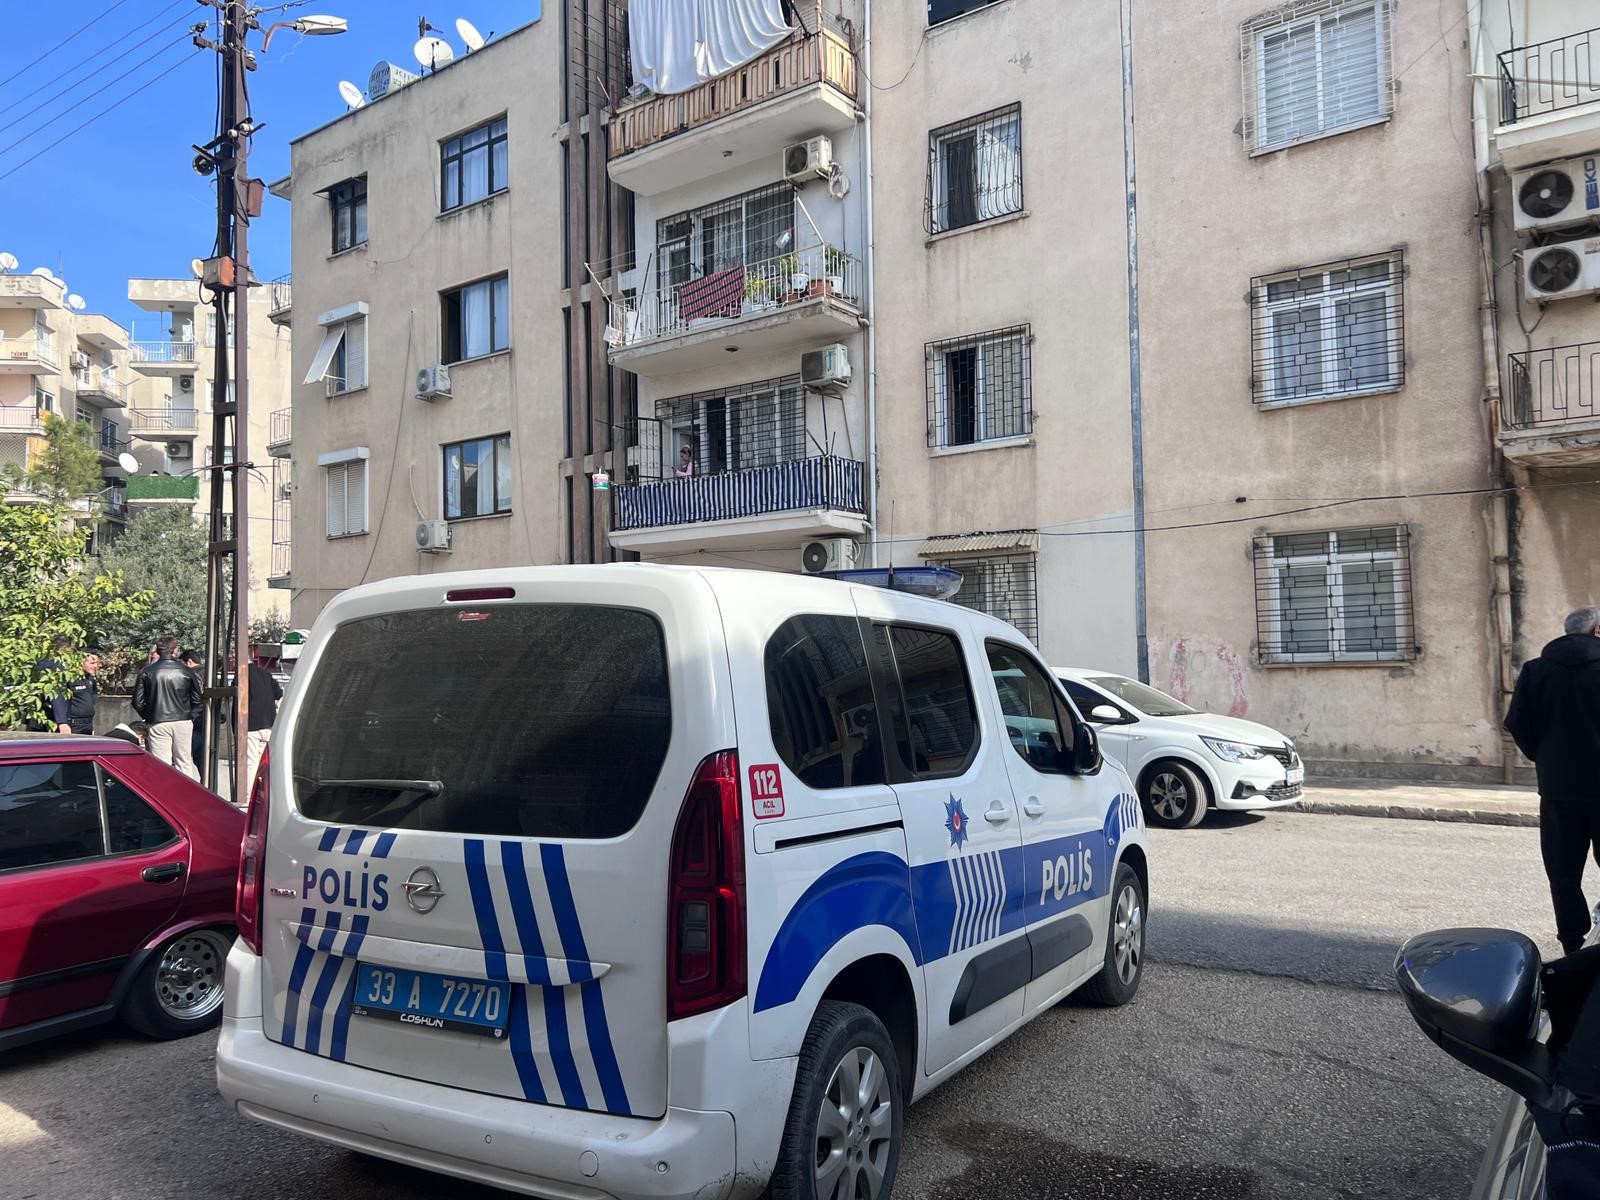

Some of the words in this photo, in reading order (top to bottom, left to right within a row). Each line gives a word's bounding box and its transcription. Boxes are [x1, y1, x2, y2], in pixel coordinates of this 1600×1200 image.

[753, 769, 778, 796] 112
[302, 860, 389, 912] POLİS
[1039, 841, 1093, 906] POLİS
[368, 970, 396, 1005] 33
[407, 975, 420, 1010] A
[439, 978, 501, 1021] 7270
